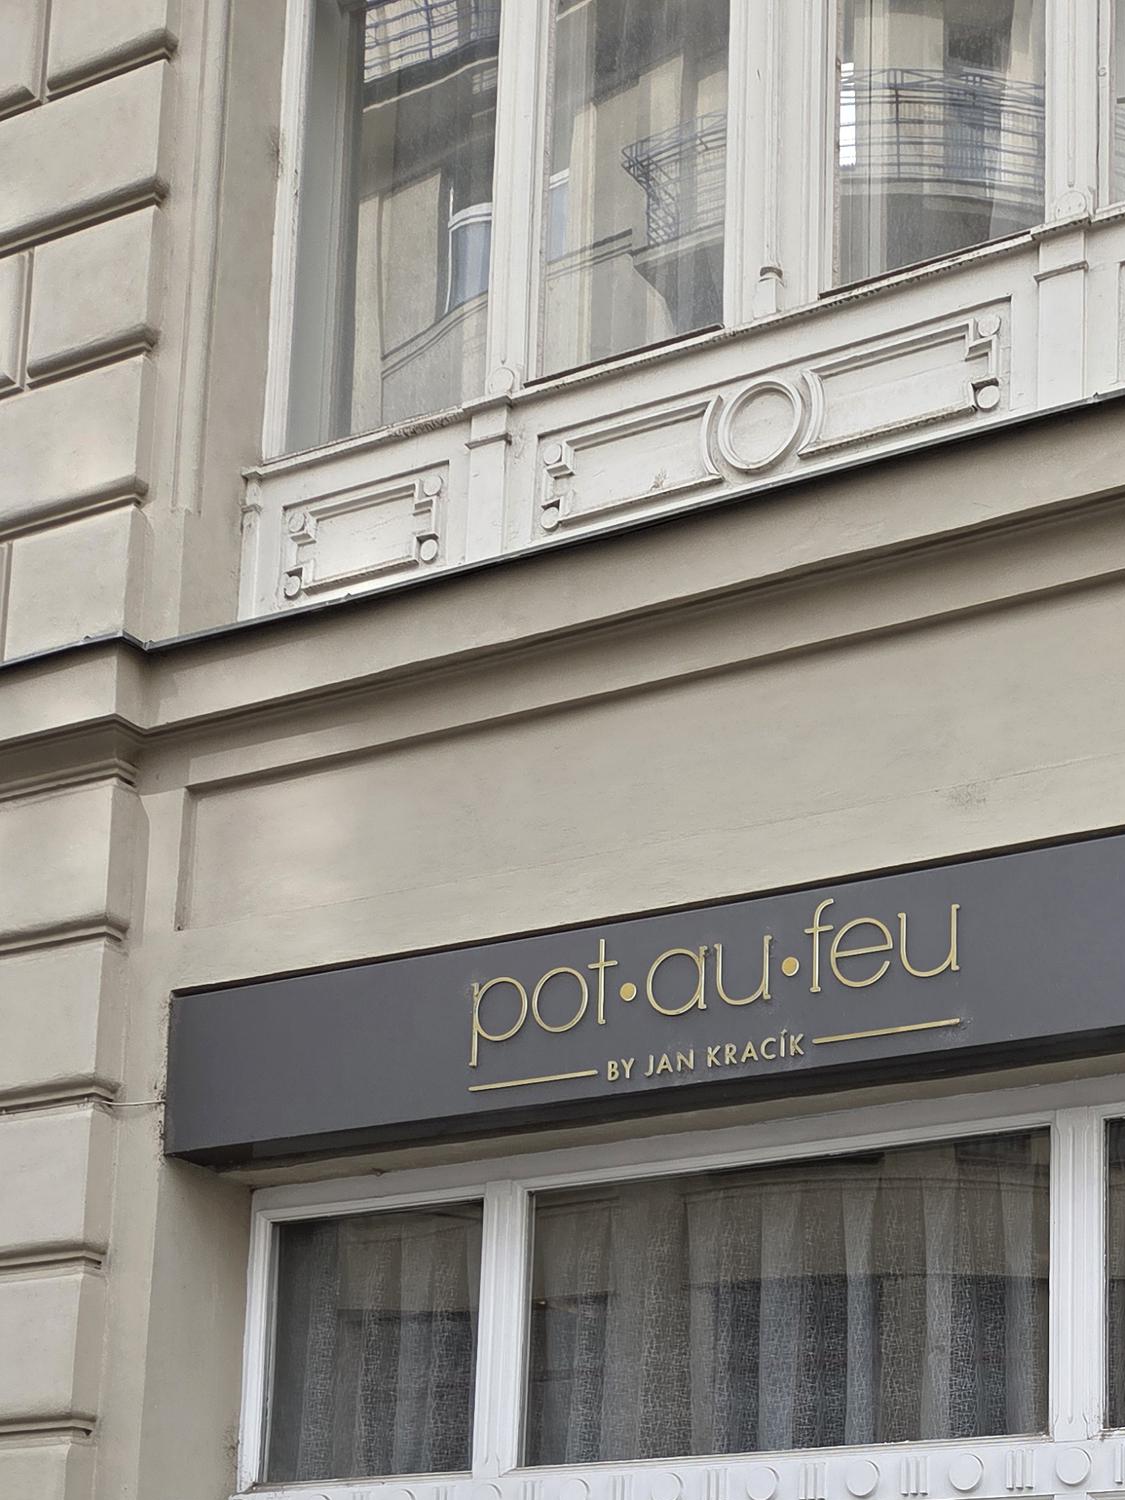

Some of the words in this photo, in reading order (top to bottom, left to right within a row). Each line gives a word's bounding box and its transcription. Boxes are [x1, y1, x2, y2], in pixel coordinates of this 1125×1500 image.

[607, 1058, 635, 1081] BY
[645, 1049, 694, 1078] JAN
[706, 1029, 805, 1068] KRACÍK
